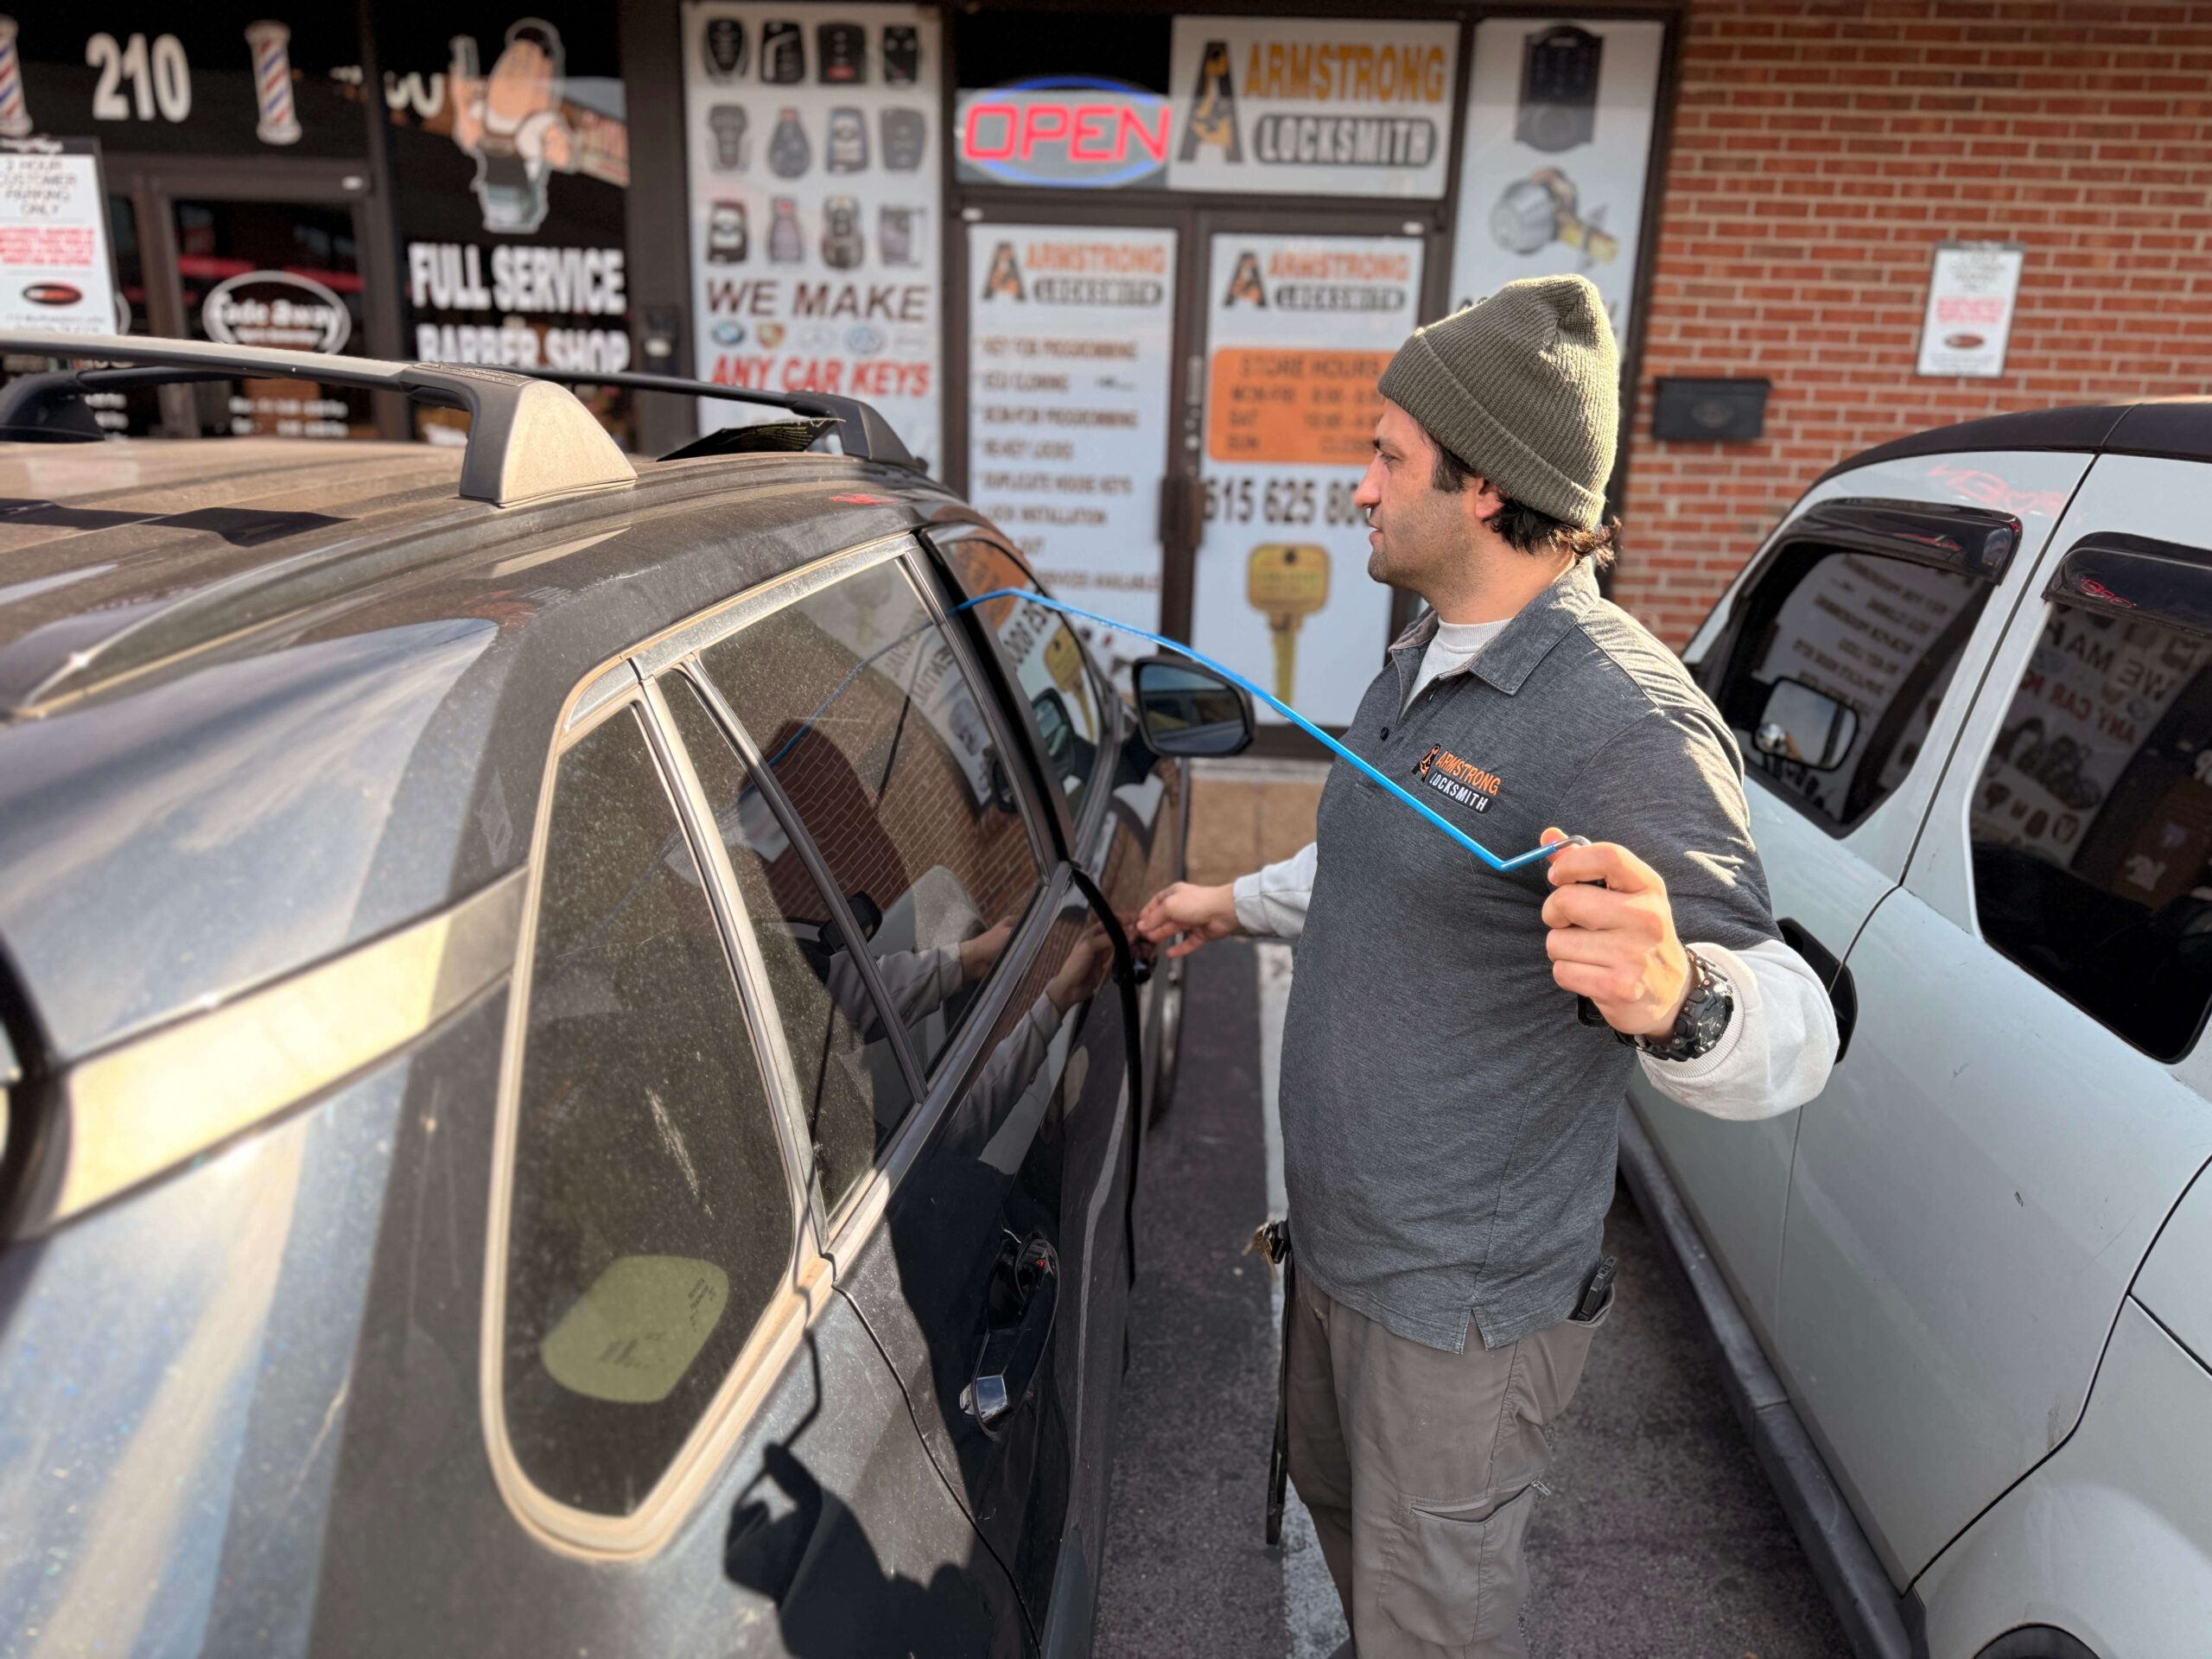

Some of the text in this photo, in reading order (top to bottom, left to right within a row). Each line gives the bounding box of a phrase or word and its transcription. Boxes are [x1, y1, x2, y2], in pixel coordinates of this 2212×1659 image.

[86, 32, 191, 122] 210
[1243, 40, 1446, 104] ARMSTRONG
[963, 103, 1173, 163] OPEN
[1260, 116, 1432, 164] LOCKSMITH
[408, 242, 627, 315] FULL SERVICE
[707, 278, 931, 323] WE MAKE
[416, 323, 541, 368] BARBER
[543, 327, 631, 372] SHOP
[1242, 355, 1381, 379] STORE HOURS
[710, 354, 932, 398] ANY CAR KEYS
[1264, 480, 1315, 524] 625
[1428, 772, 1489, 812] LOCKSMITH
[1435, 750, 1502, 796] ARMSTRONG
